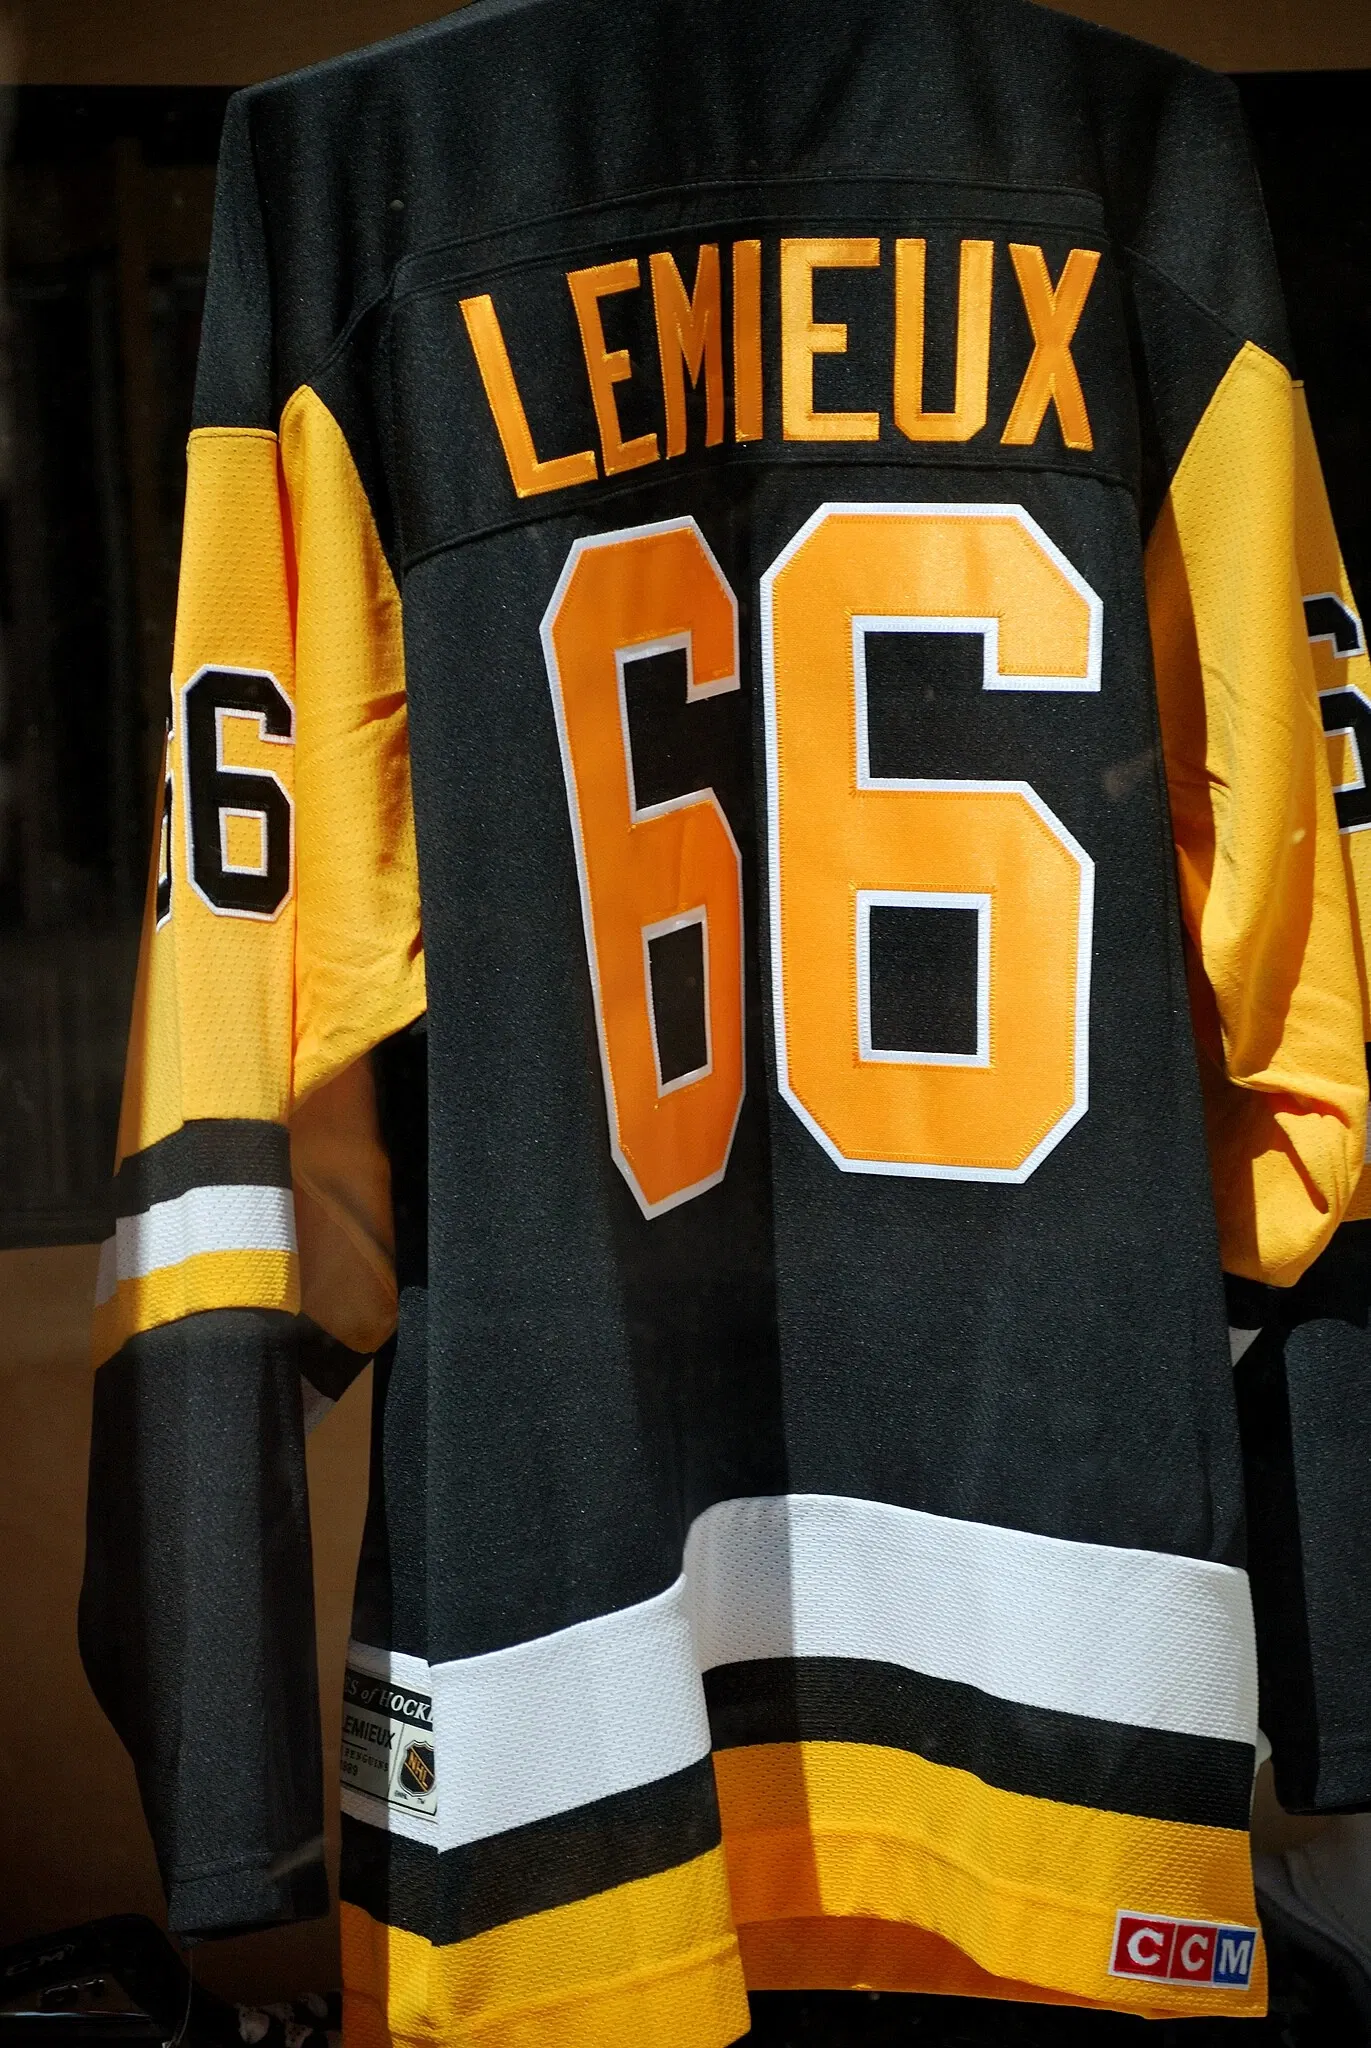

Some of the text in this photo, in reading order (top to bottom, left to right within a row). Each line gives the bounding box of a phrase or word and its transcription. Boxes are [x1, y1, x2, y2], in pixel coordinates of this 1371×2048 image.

[458, 237, 1101, 498] LEMIEUX
[156, 664, 296, 933] 6
[539, 502, 1104, 1221] 66
[361, 1688, 379, 1704] of
[379, 1689, 434, 1723] HOCK
[342, 1715, 395, 1749] EMIEUX
[408, 1751, 429, 1788] NHL
[1127, 1927, 1251, 1976] CCM
